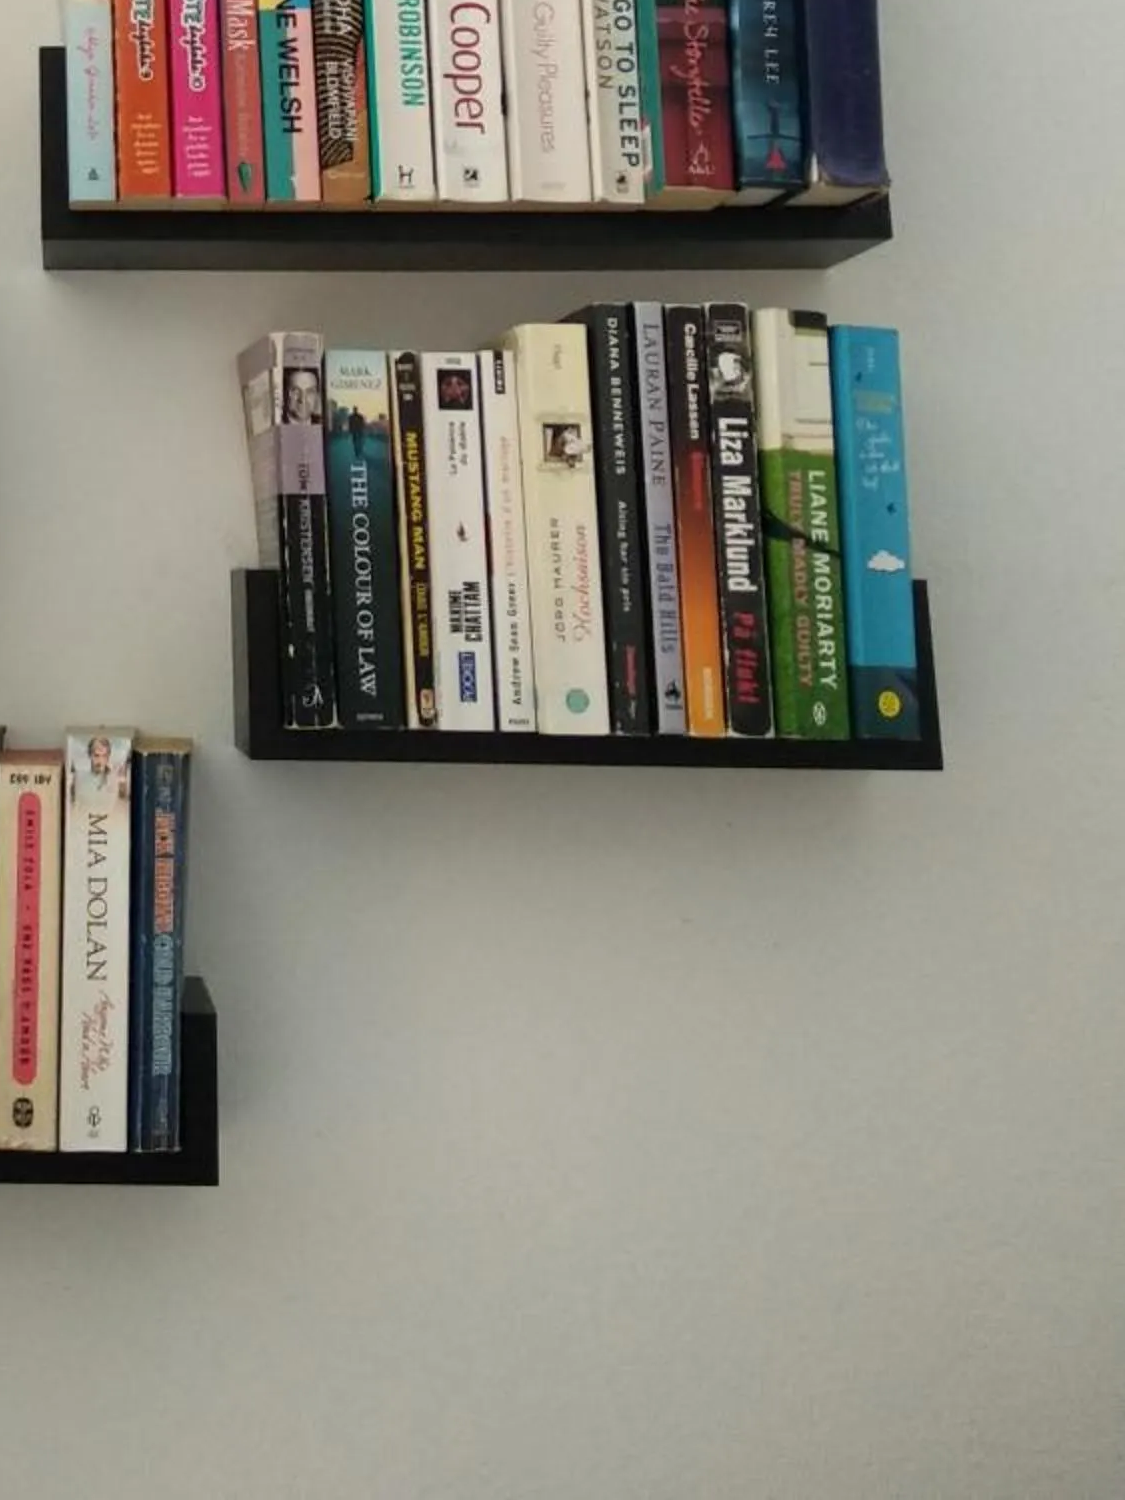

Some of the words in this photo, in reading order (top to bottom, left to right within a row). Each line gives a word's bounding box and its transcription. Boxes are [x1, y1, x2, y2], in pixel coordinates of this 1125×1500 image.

[226, 0, 253, 51] Mask
[615, 40, 635, 73] TO
[276, 36, 303, 134] WELSH
[442, 1, 492, 136] Cooper
[669, 16, 712, 128] Storyteller
[764, 48, 780, 85] LEE
[617, 84, 641, 168] SLEEP
[605, 317, 621, 370] DIANA
[642, 323, 662, 412] LAURAN
[609, 377, 627, 474] BENNEWEIS
[646, 420, 666, 485] PAINE
[717, 416, 750, 464] Liza
[349, 462, 369, 507] THE
[405, 431, 422, 522] MUSTANG
[808, 469, 830, 541] LIANE
[352, 512, 371, 604] COLOUR
[411, 526, 426, 569] MAN
[654, 523, 672, 554] The
[722, 474, 757, 593] Marklund
[657, 561, 674, 603] Bald
[356, 609, 373, 639] OF
[812, 551, 837, 689] MORIARTY
[358, 646, 376, 697] LAW
[86, 813, 108, 868] MIA
[86, 876, 109, 982] DOLAN
